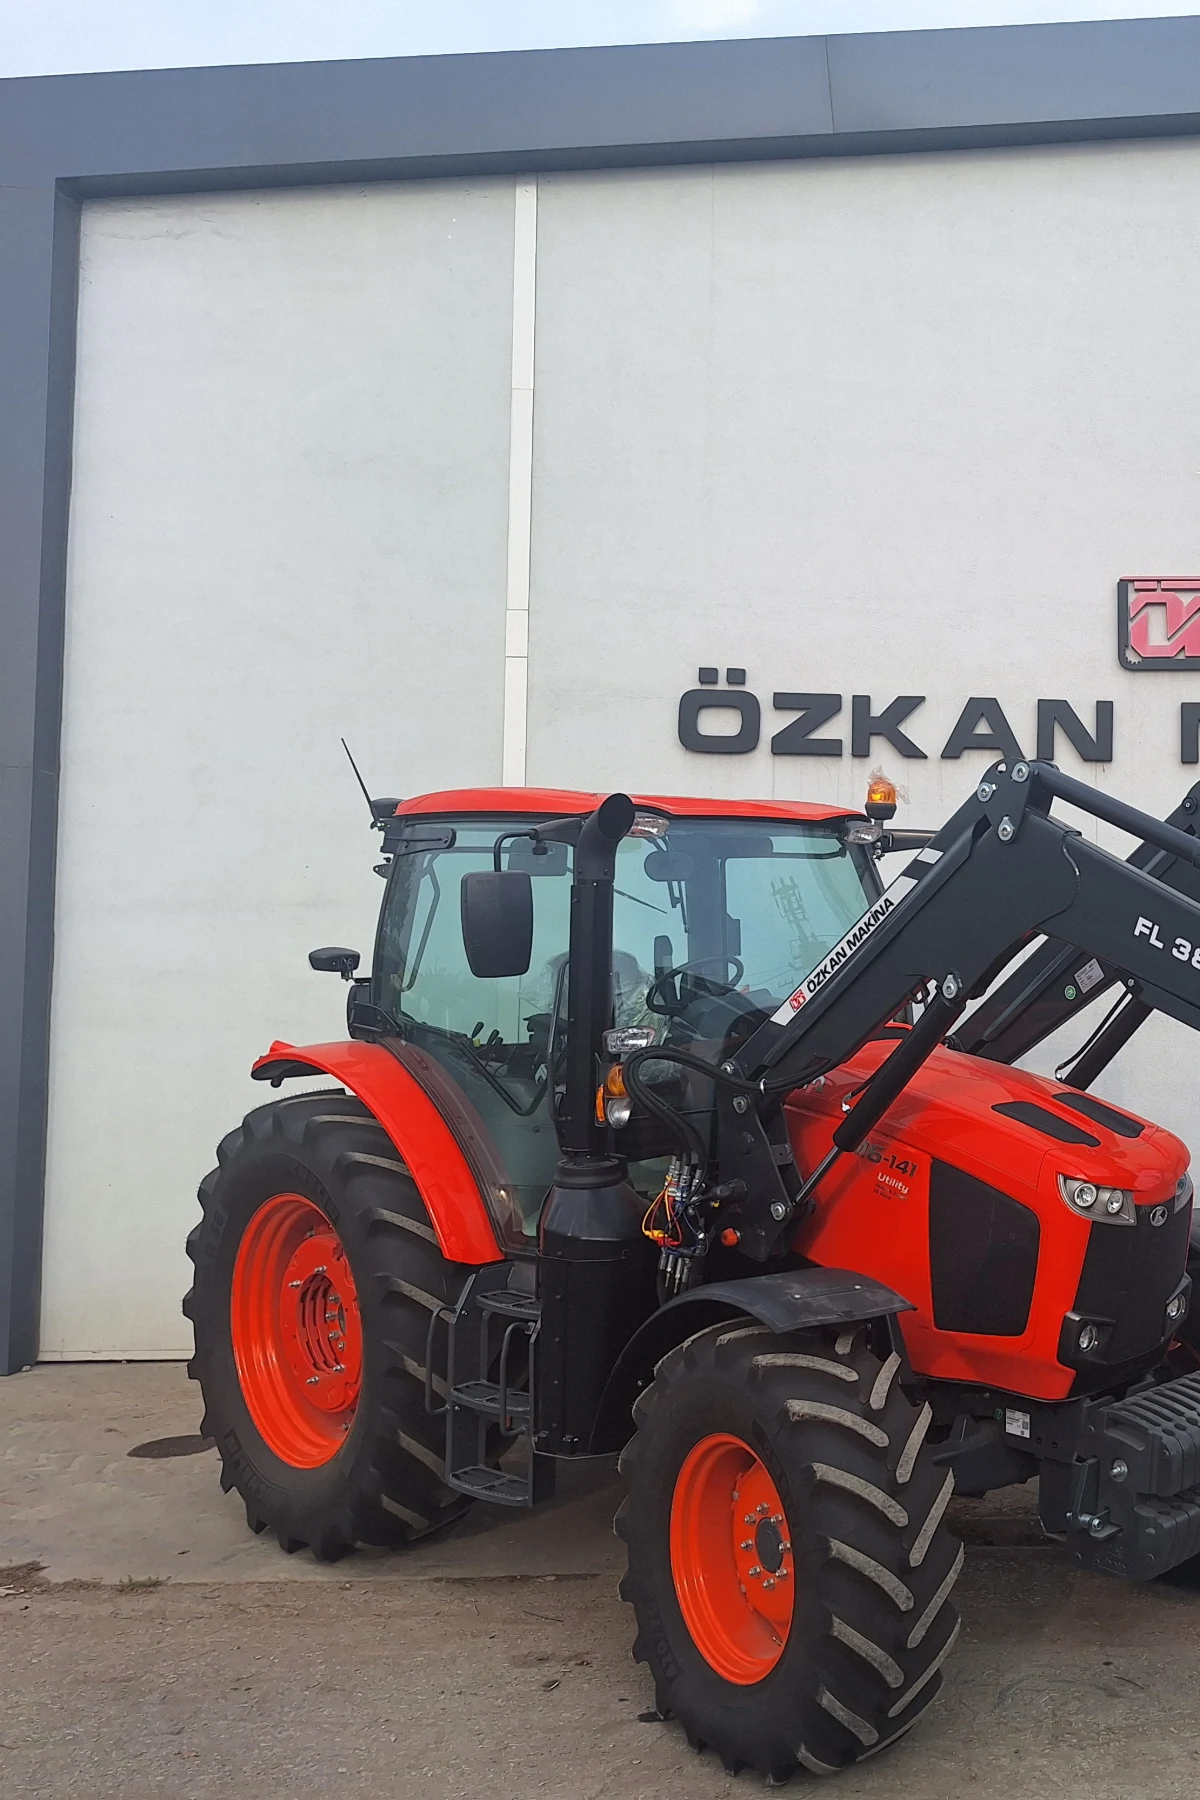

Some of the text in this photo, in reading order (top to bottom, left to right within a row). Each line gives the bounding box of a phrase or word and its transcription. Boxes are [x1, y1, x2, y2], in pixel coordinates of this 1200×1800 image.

[678, 667, 1113, 763] ÖZKAN
[806, 946, 848, 993] ÖZKAN
[845, 897, 895, 952] MAKİNA
[1133, 916, 1165, 950] FL
[877, 1172, 909, 1194] Utility
